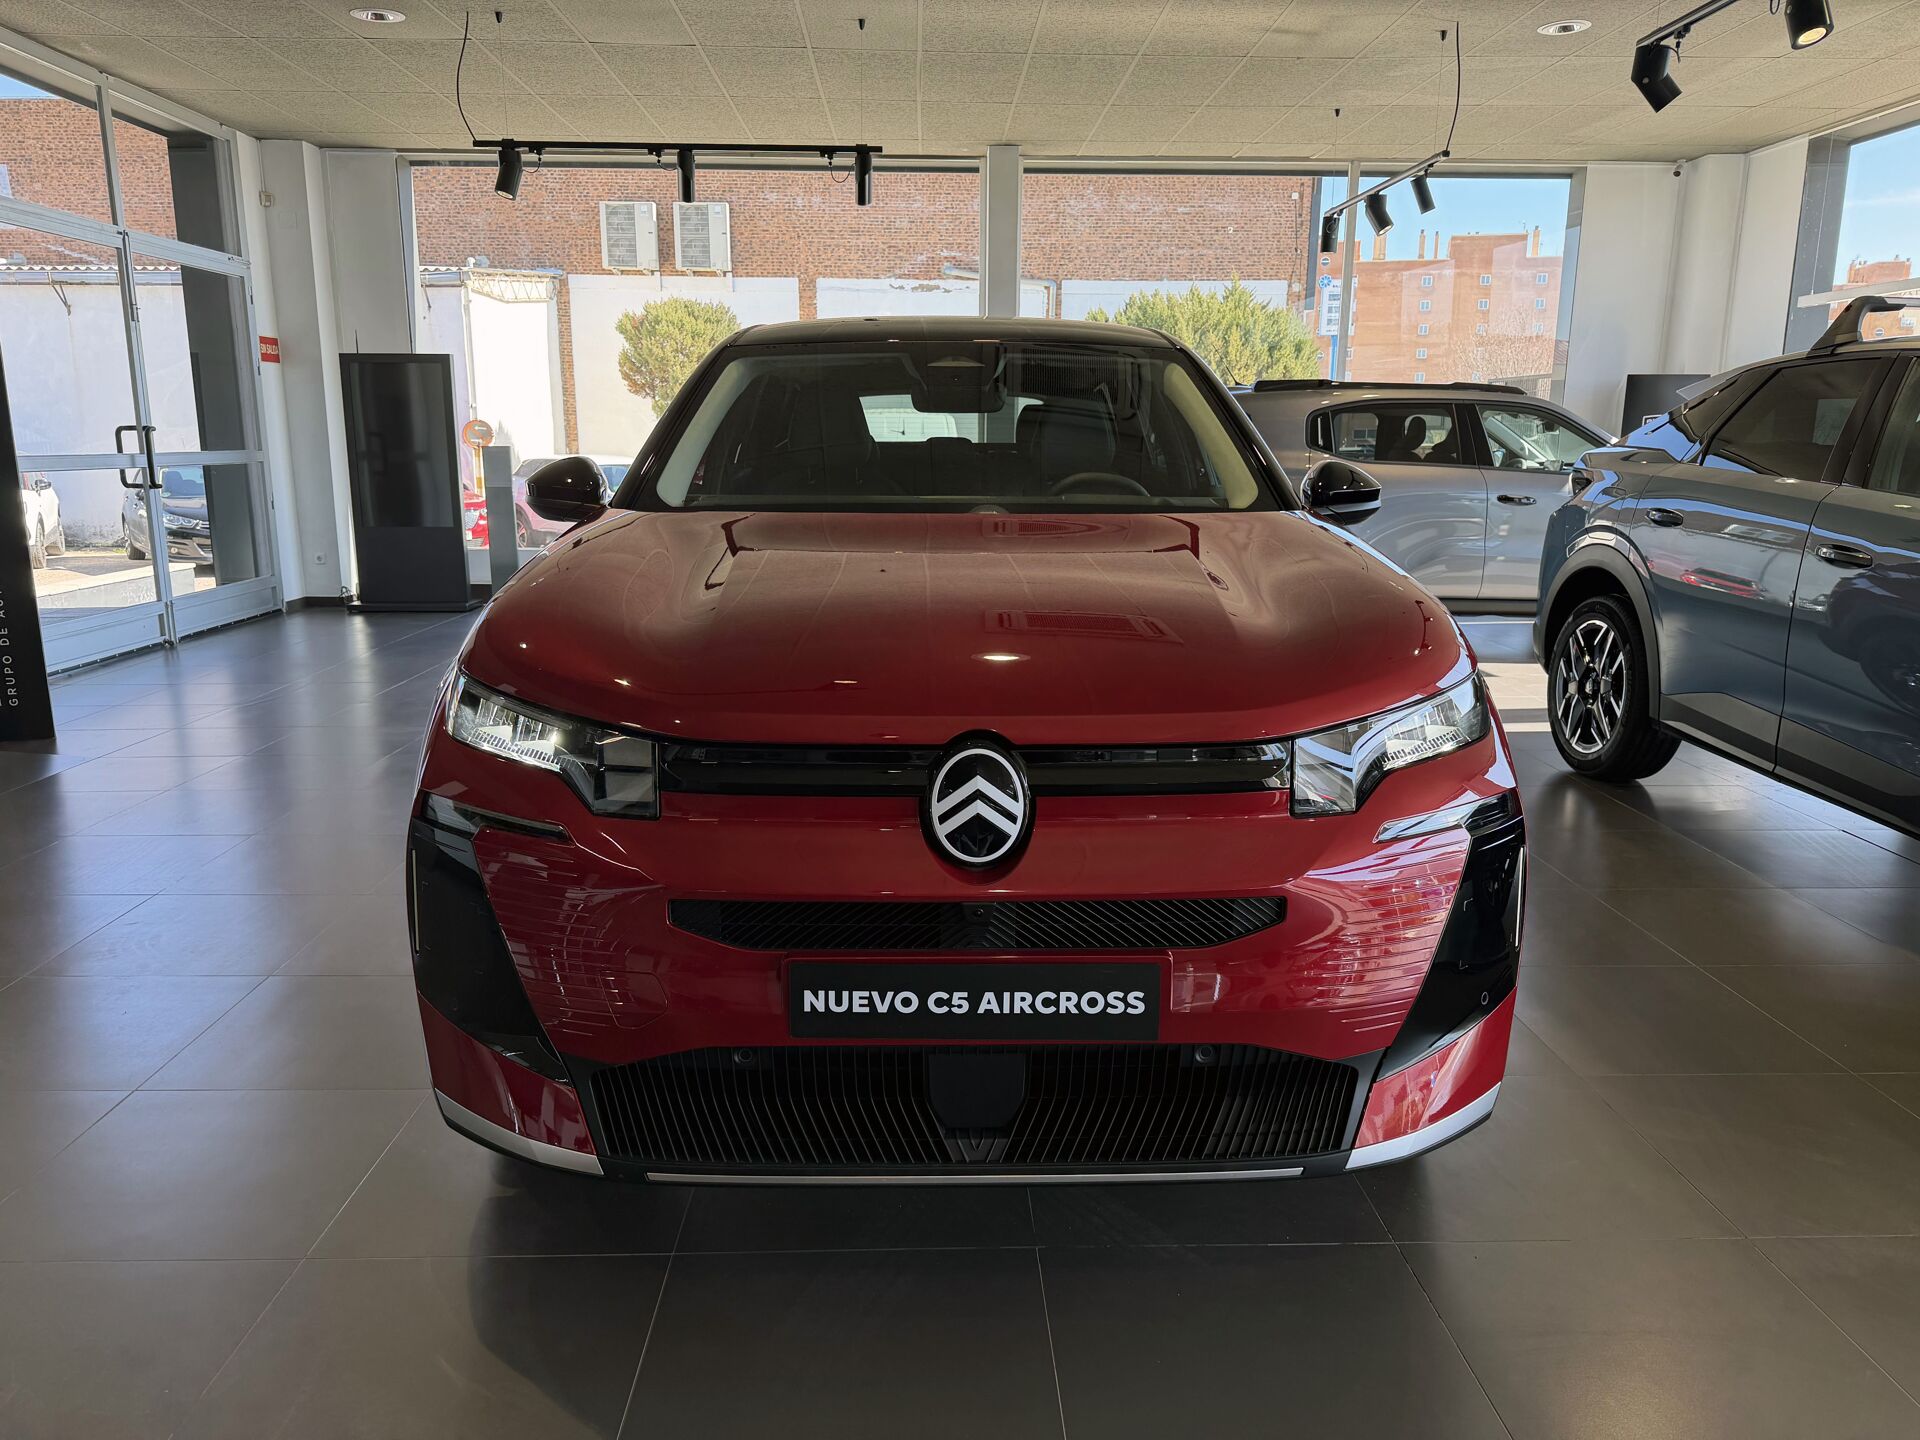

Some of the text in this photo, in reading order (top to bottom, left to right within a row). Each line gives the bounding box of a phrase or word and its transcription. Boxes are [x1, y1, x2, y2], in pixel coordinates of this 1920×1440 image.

[0, 627, 10, 645] DE
[3, 655, 19, 706] GRUPO
[803, 990, 1146, 1014] NUEVO C5 AIRCROSS
